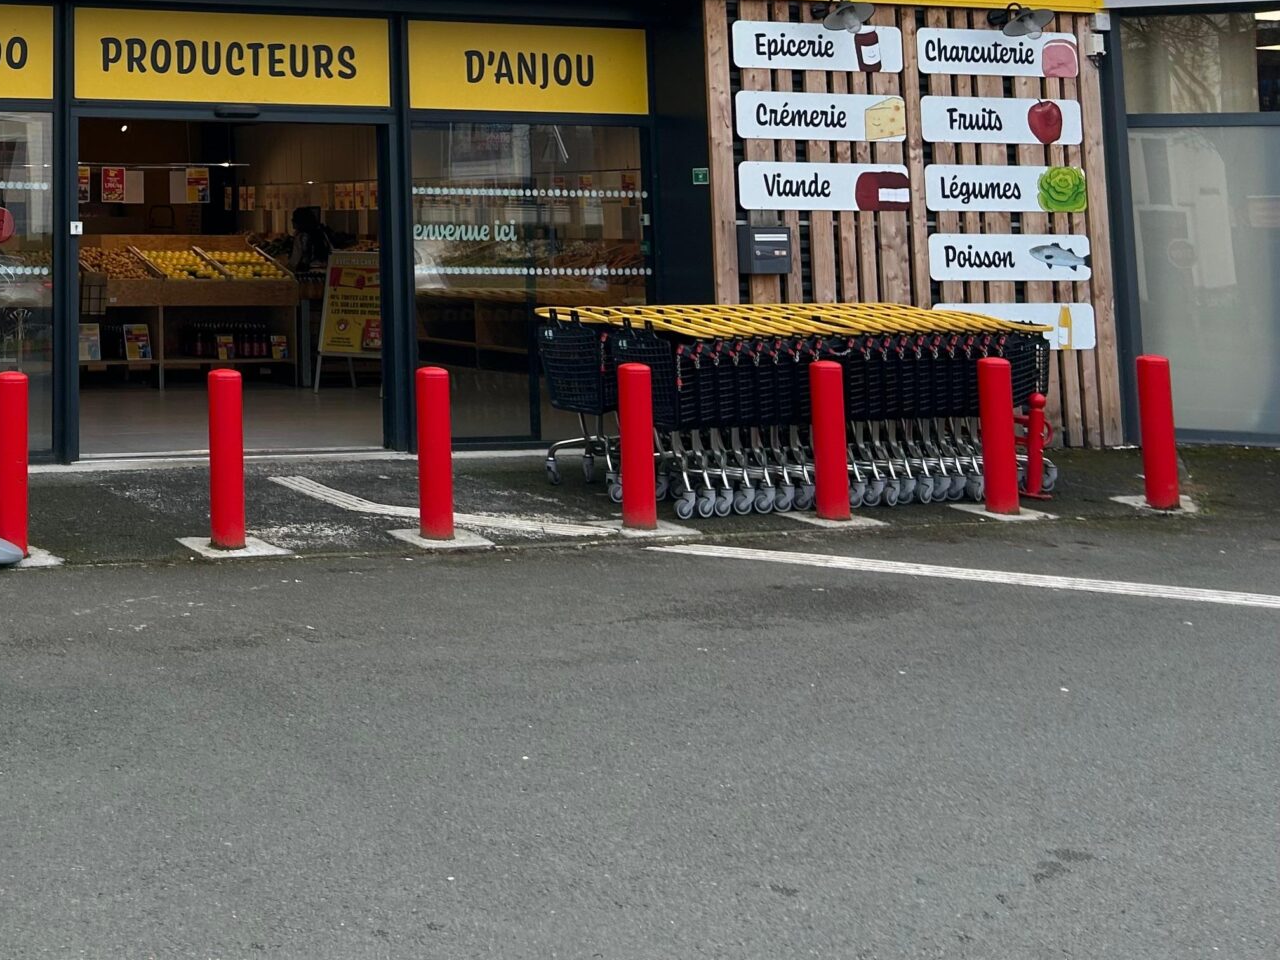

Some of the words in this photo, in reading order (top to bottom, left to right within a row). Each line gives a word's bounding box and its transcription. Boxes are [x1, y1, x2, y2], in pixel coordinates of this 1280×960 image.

[100, 36, 357, 80] PRODUCTEURS
[755, 34, 835, 61] Epicerie
[924, 39, 1035, 66] Charcuterie
[465, 50, 595, 88] D'ANJOU
[756, 102, 847, 130] Crémerie
[947, 107, 1003, 132] Fruits
[763, 172, 831, 198] Viande
[941, 176, 1022, 204] Légumes
[494, 220, 517, 241] ici
[944, 245, 1015, 270] Poisson
